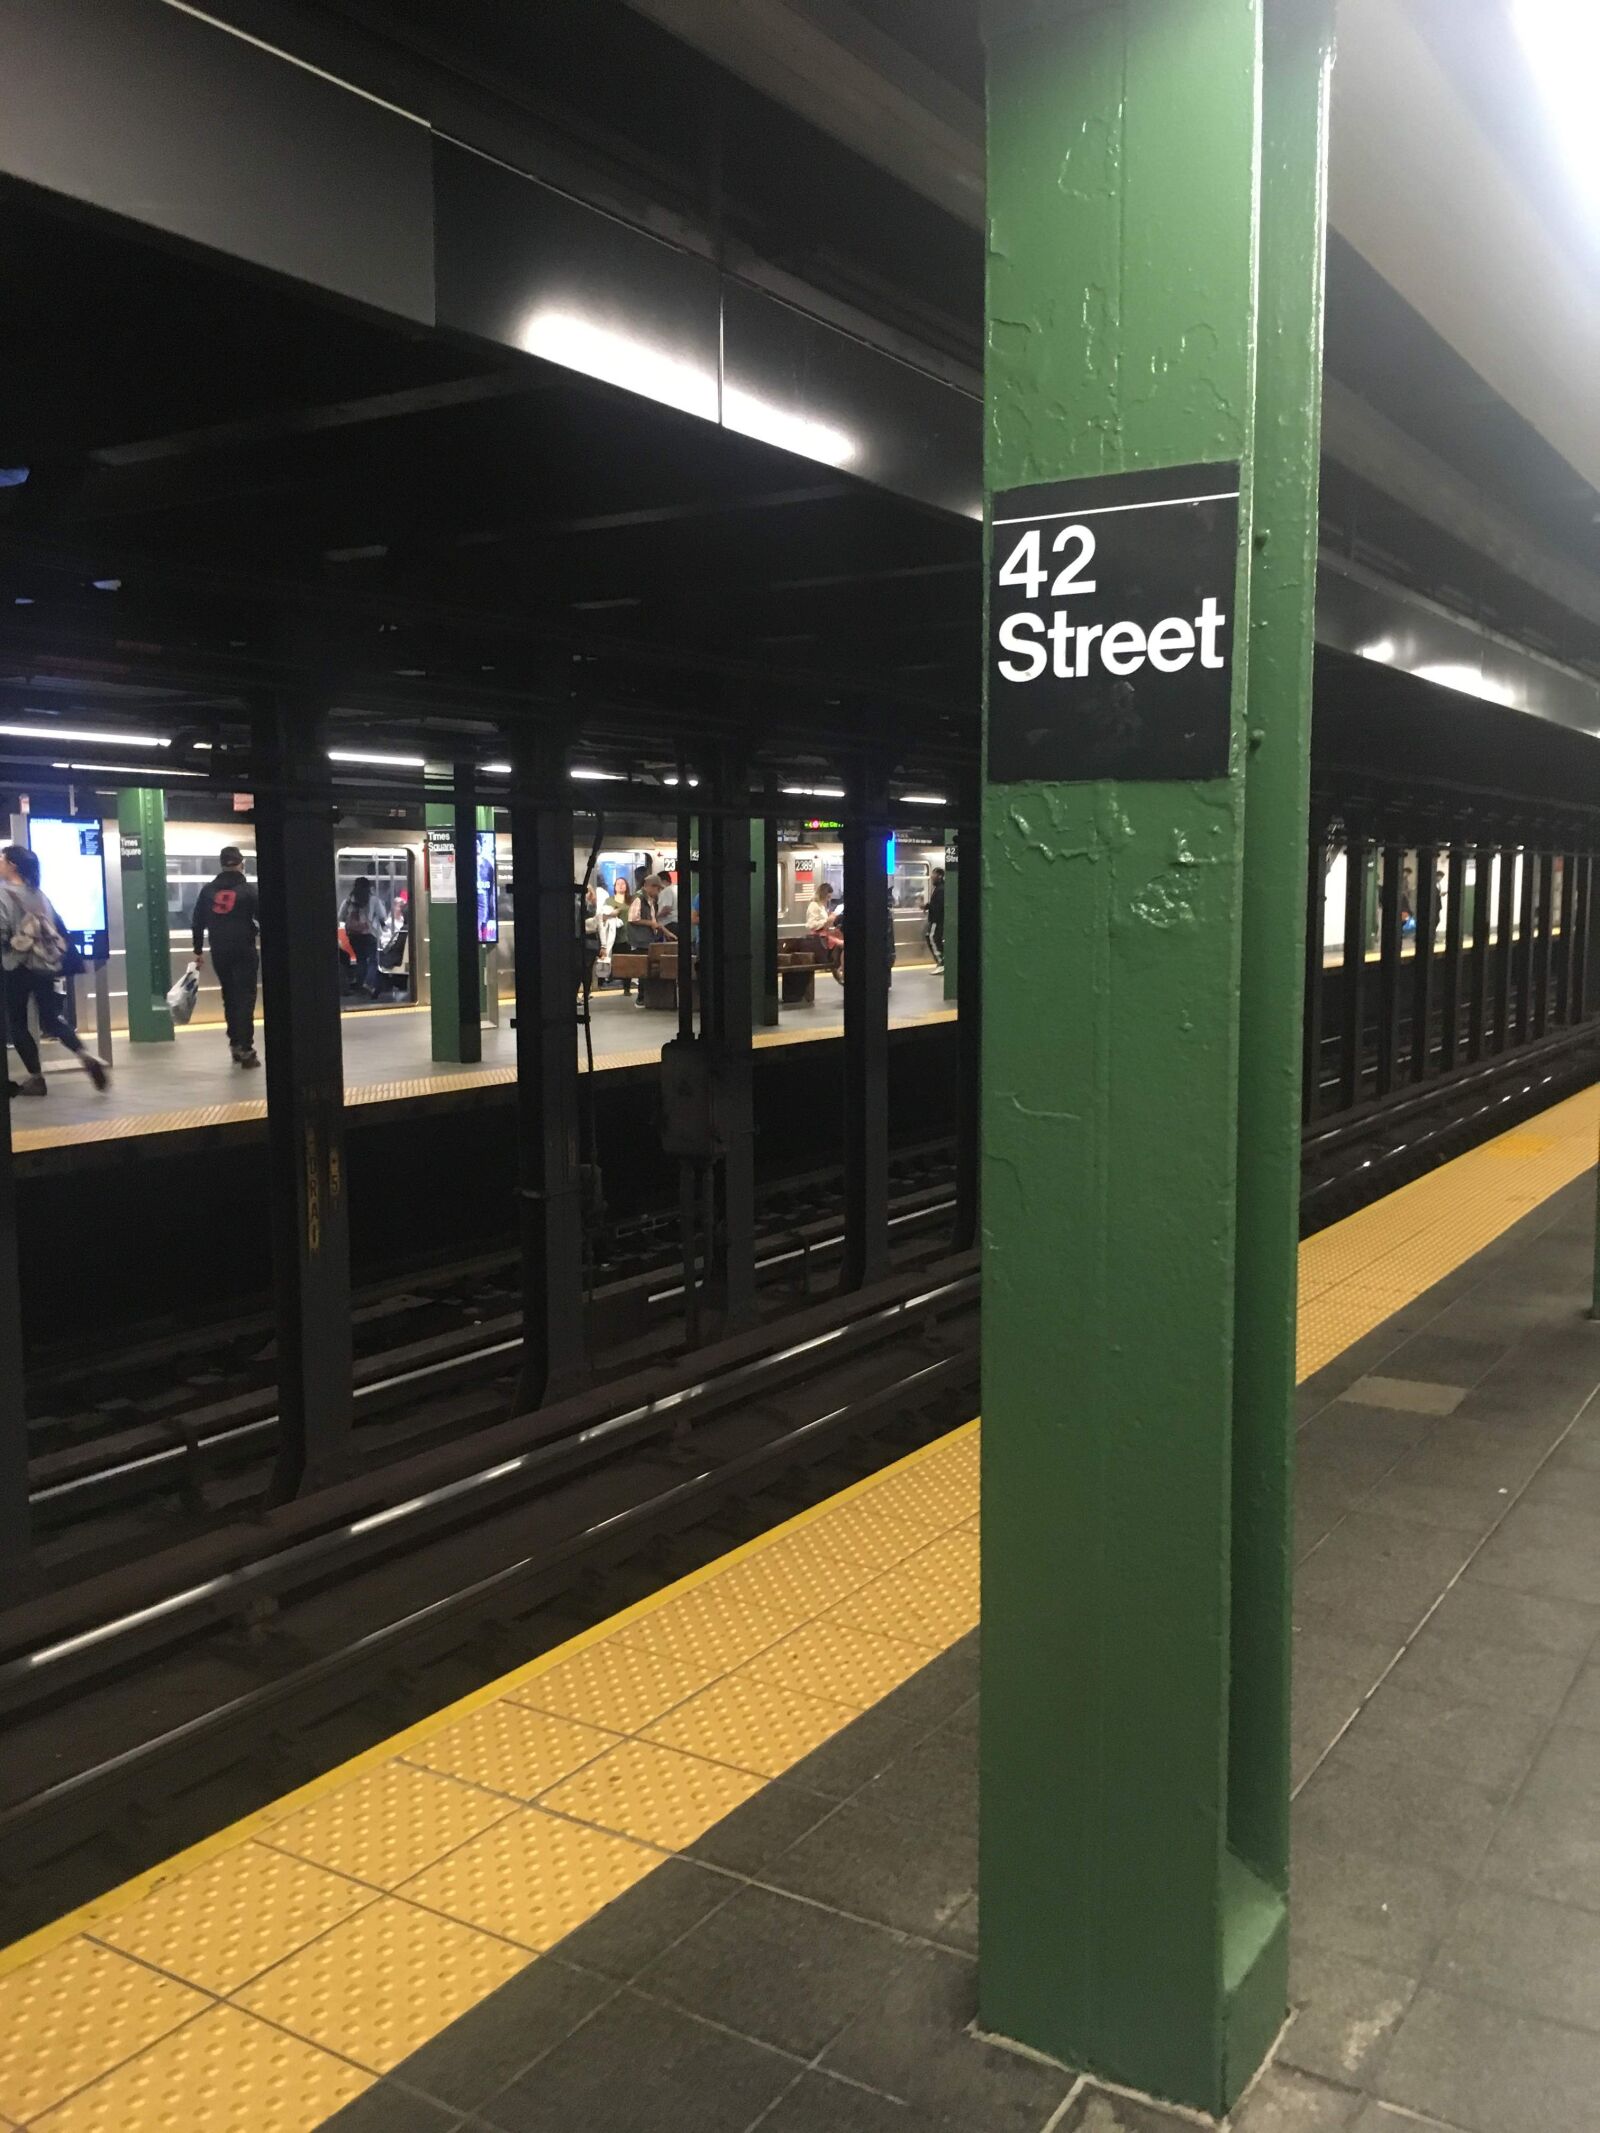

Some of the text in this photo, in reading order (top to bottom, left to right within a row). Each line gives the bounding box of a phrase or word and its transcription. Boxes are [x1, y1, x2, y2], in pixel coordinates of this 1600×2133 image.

[998, 525, 1096, 598] 42
[997, 597, 1226, 683] Street
[428, 831, 450, 841] Times
[121, 838, 138, 847] Times
[428, 841, 455, 852] Square
[121, 848, 142, 857] Square
[945, 847, 956, 855] 42
[212, 889, 237, 914] 9
